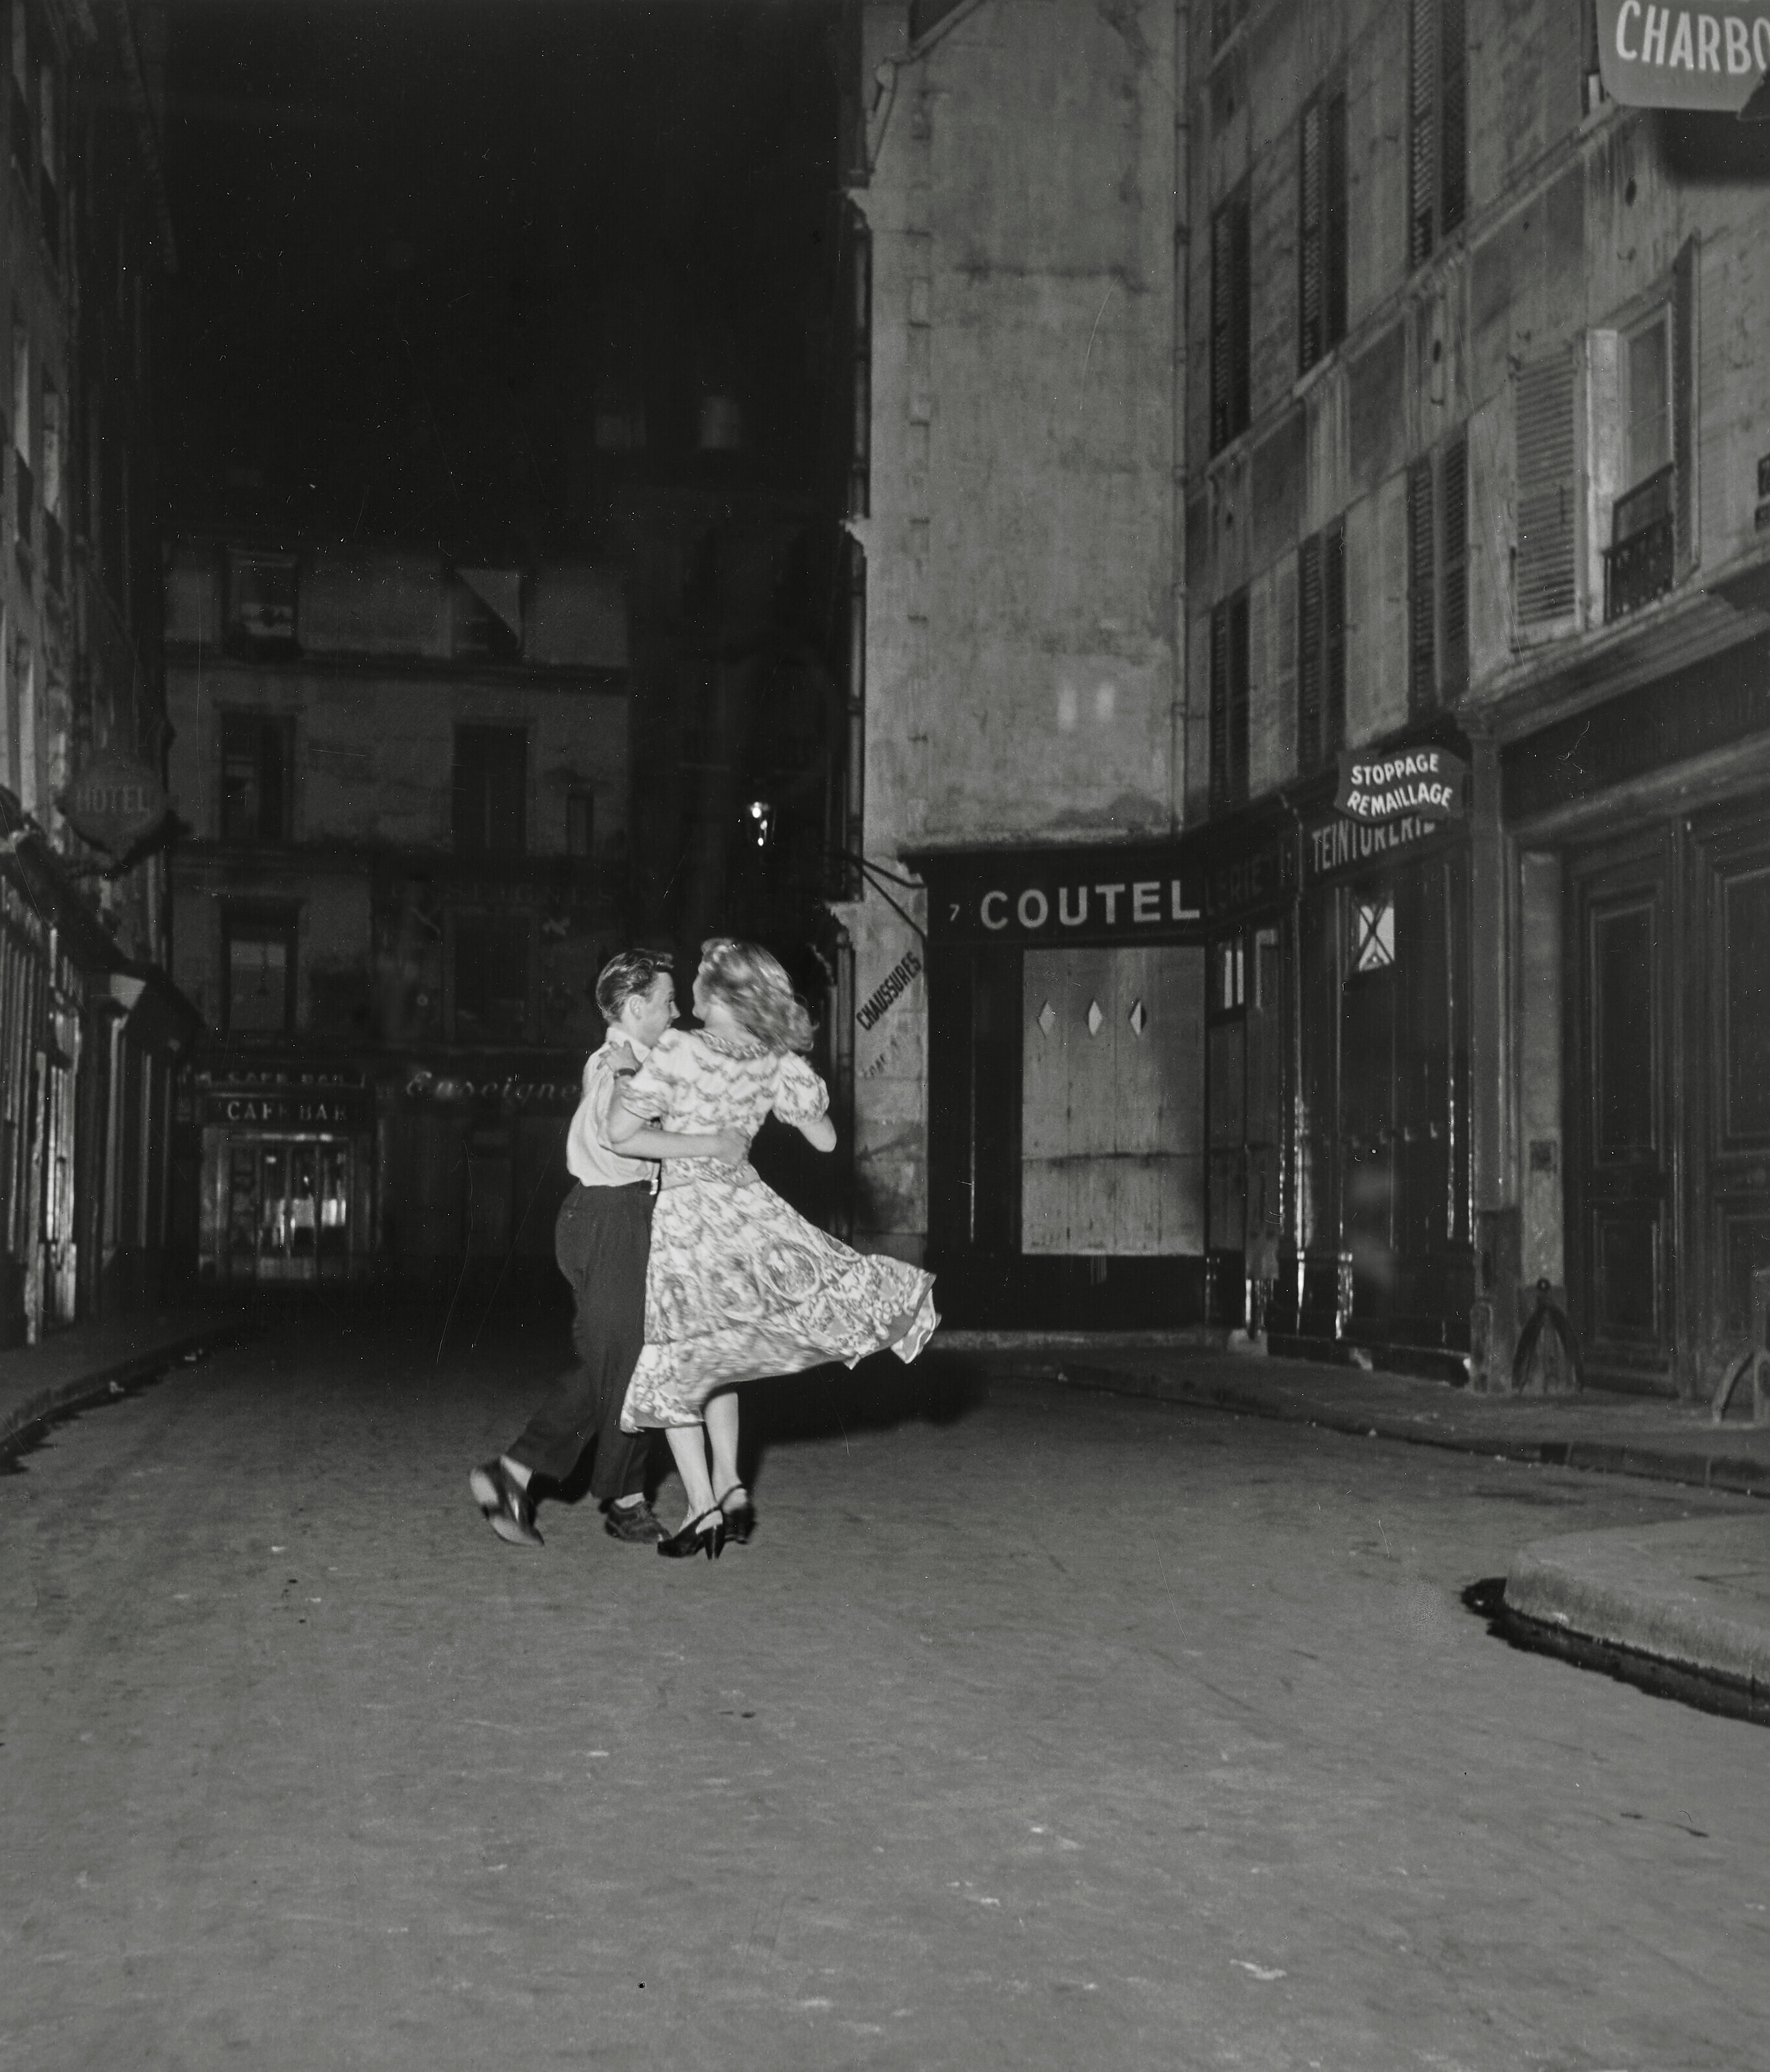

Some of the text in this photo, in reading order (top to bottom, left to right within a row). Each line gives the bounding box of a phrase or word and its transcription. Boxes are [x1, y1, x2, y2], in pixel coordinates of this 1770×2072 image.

[1351, 753, 1439, 785] STOPPAGE
[1346, 782, 1453, 817] REMAILLAGE
[949, 879, 1200, 930] 7 COUTEL
[856, 952, 922, 1031] CHAUSSURES
